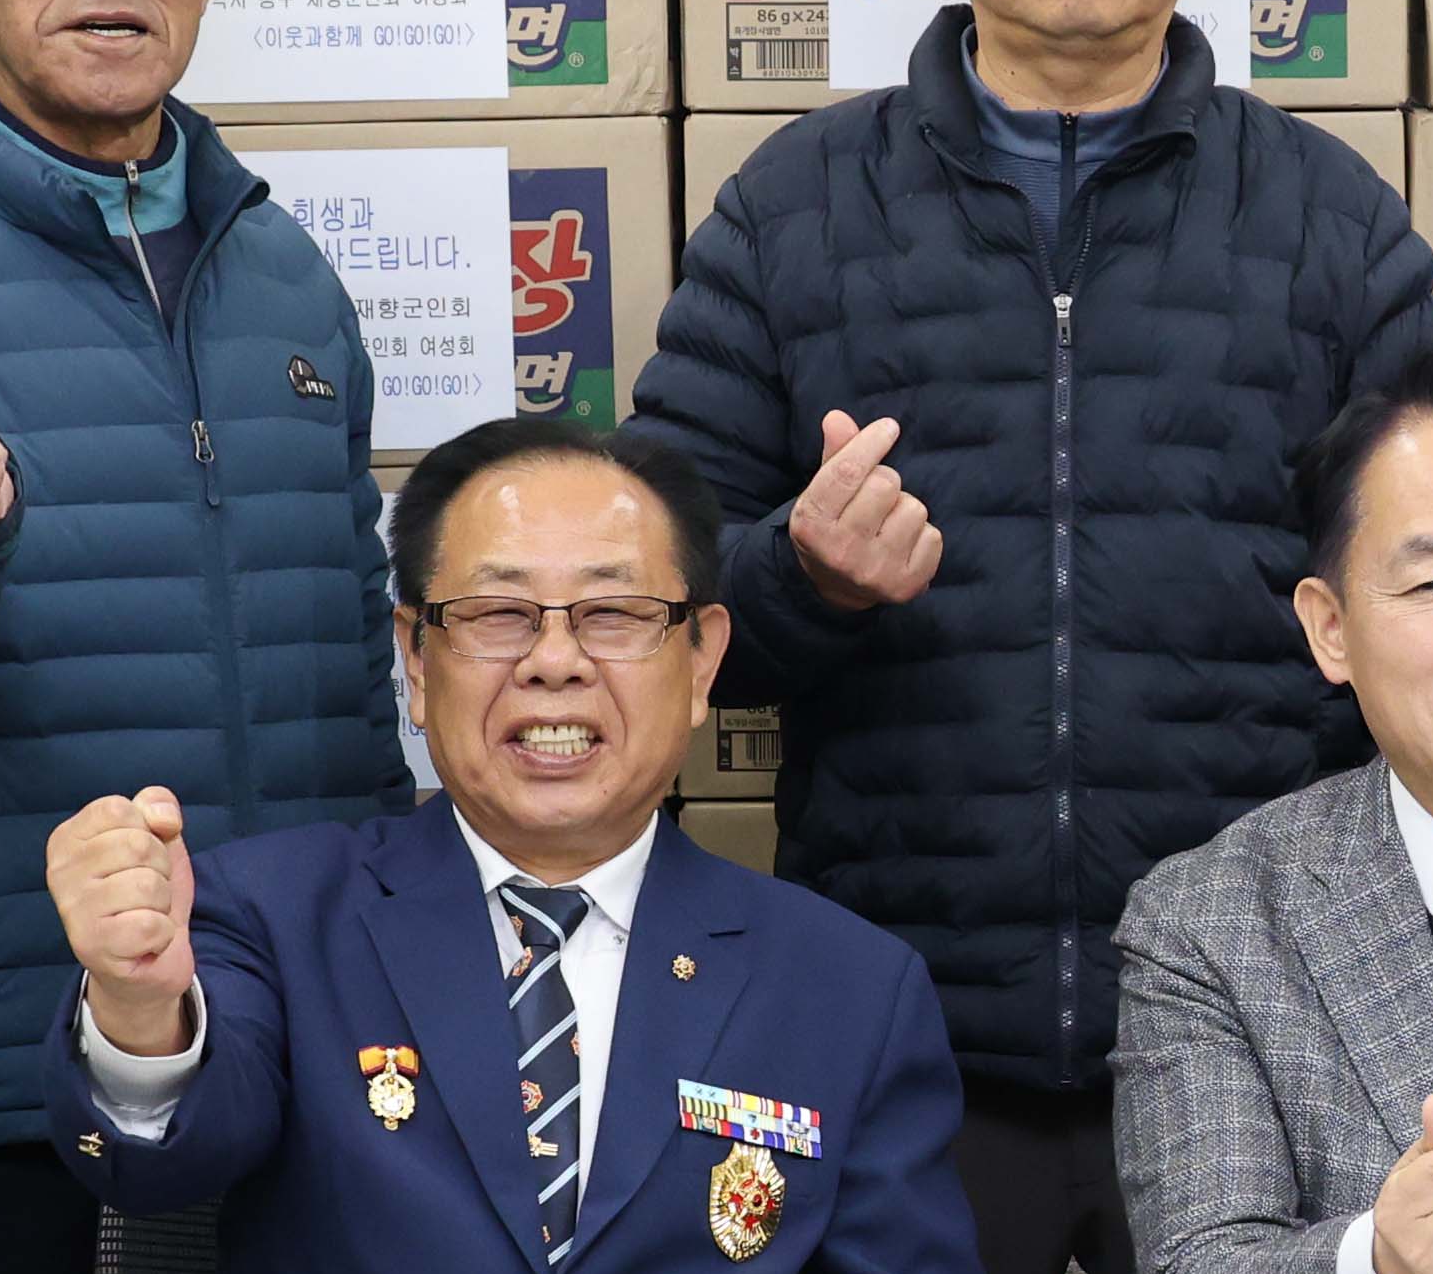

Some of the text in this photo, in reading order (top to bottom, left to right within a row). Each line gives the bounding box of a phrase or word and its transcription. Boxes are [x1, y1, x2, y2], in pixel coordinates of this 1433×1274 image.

[757, 9, 777, 22] 86
[356, 298, 469, 322] 재향군인회
[421, 336, 474, 357] 여성회
